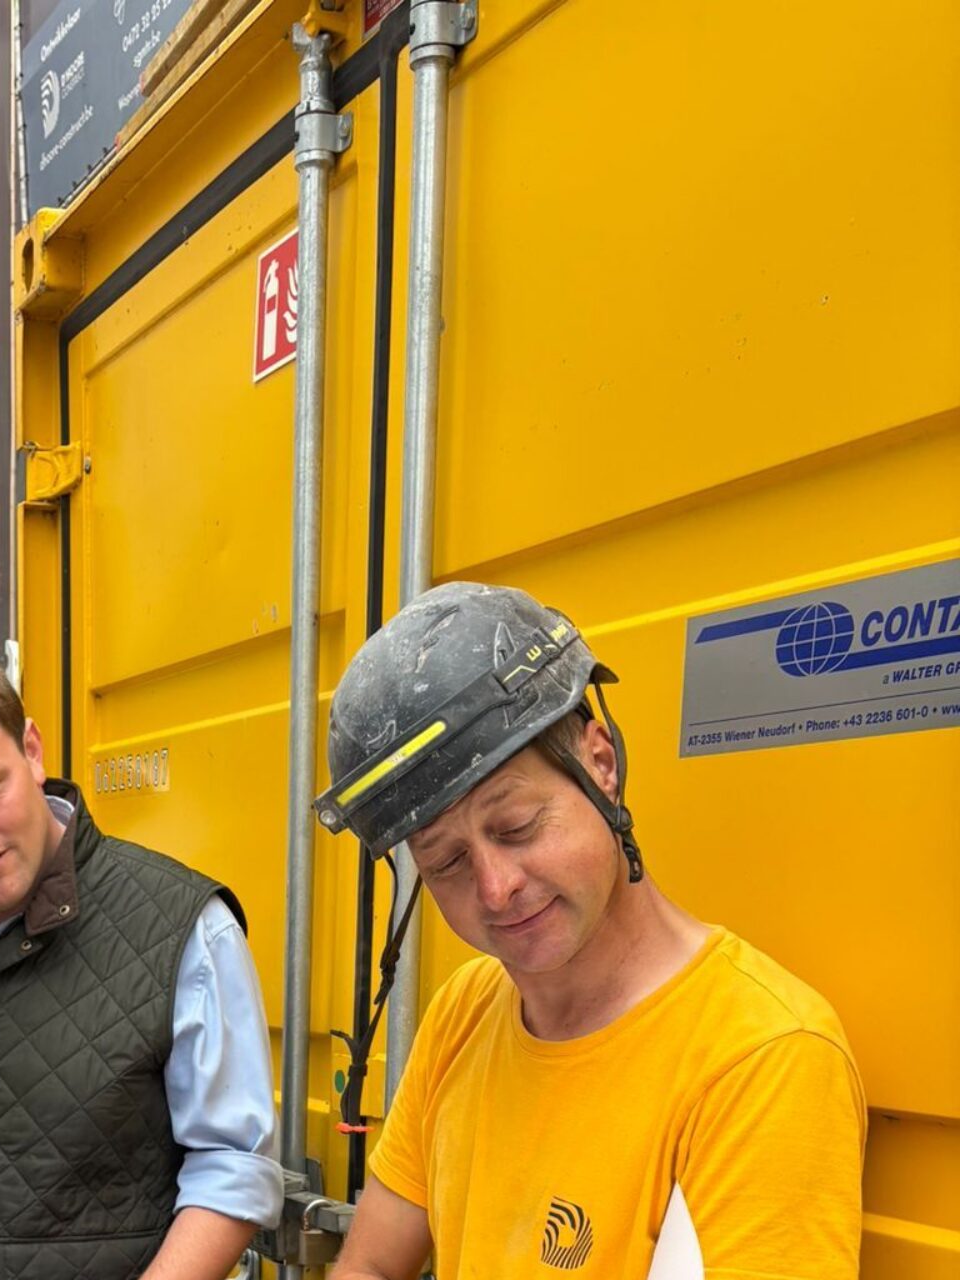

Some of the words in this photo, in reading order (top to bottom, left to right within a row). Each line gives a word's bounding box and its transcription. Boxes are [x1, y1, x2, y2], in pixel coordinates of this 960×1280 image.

[892, 664, 942, 683] WALTER
[687, 732, 722, 746] AT-2355
[724, 729, 756, 742] Wiener
[757, 722, 796, 738] Neudorf
[805, 718, 840, 732] Phone:
[843, 713, 862, 727] +43
[865, 710, 893, 725] 2236
[895, 705, 929, 720] 601-0
